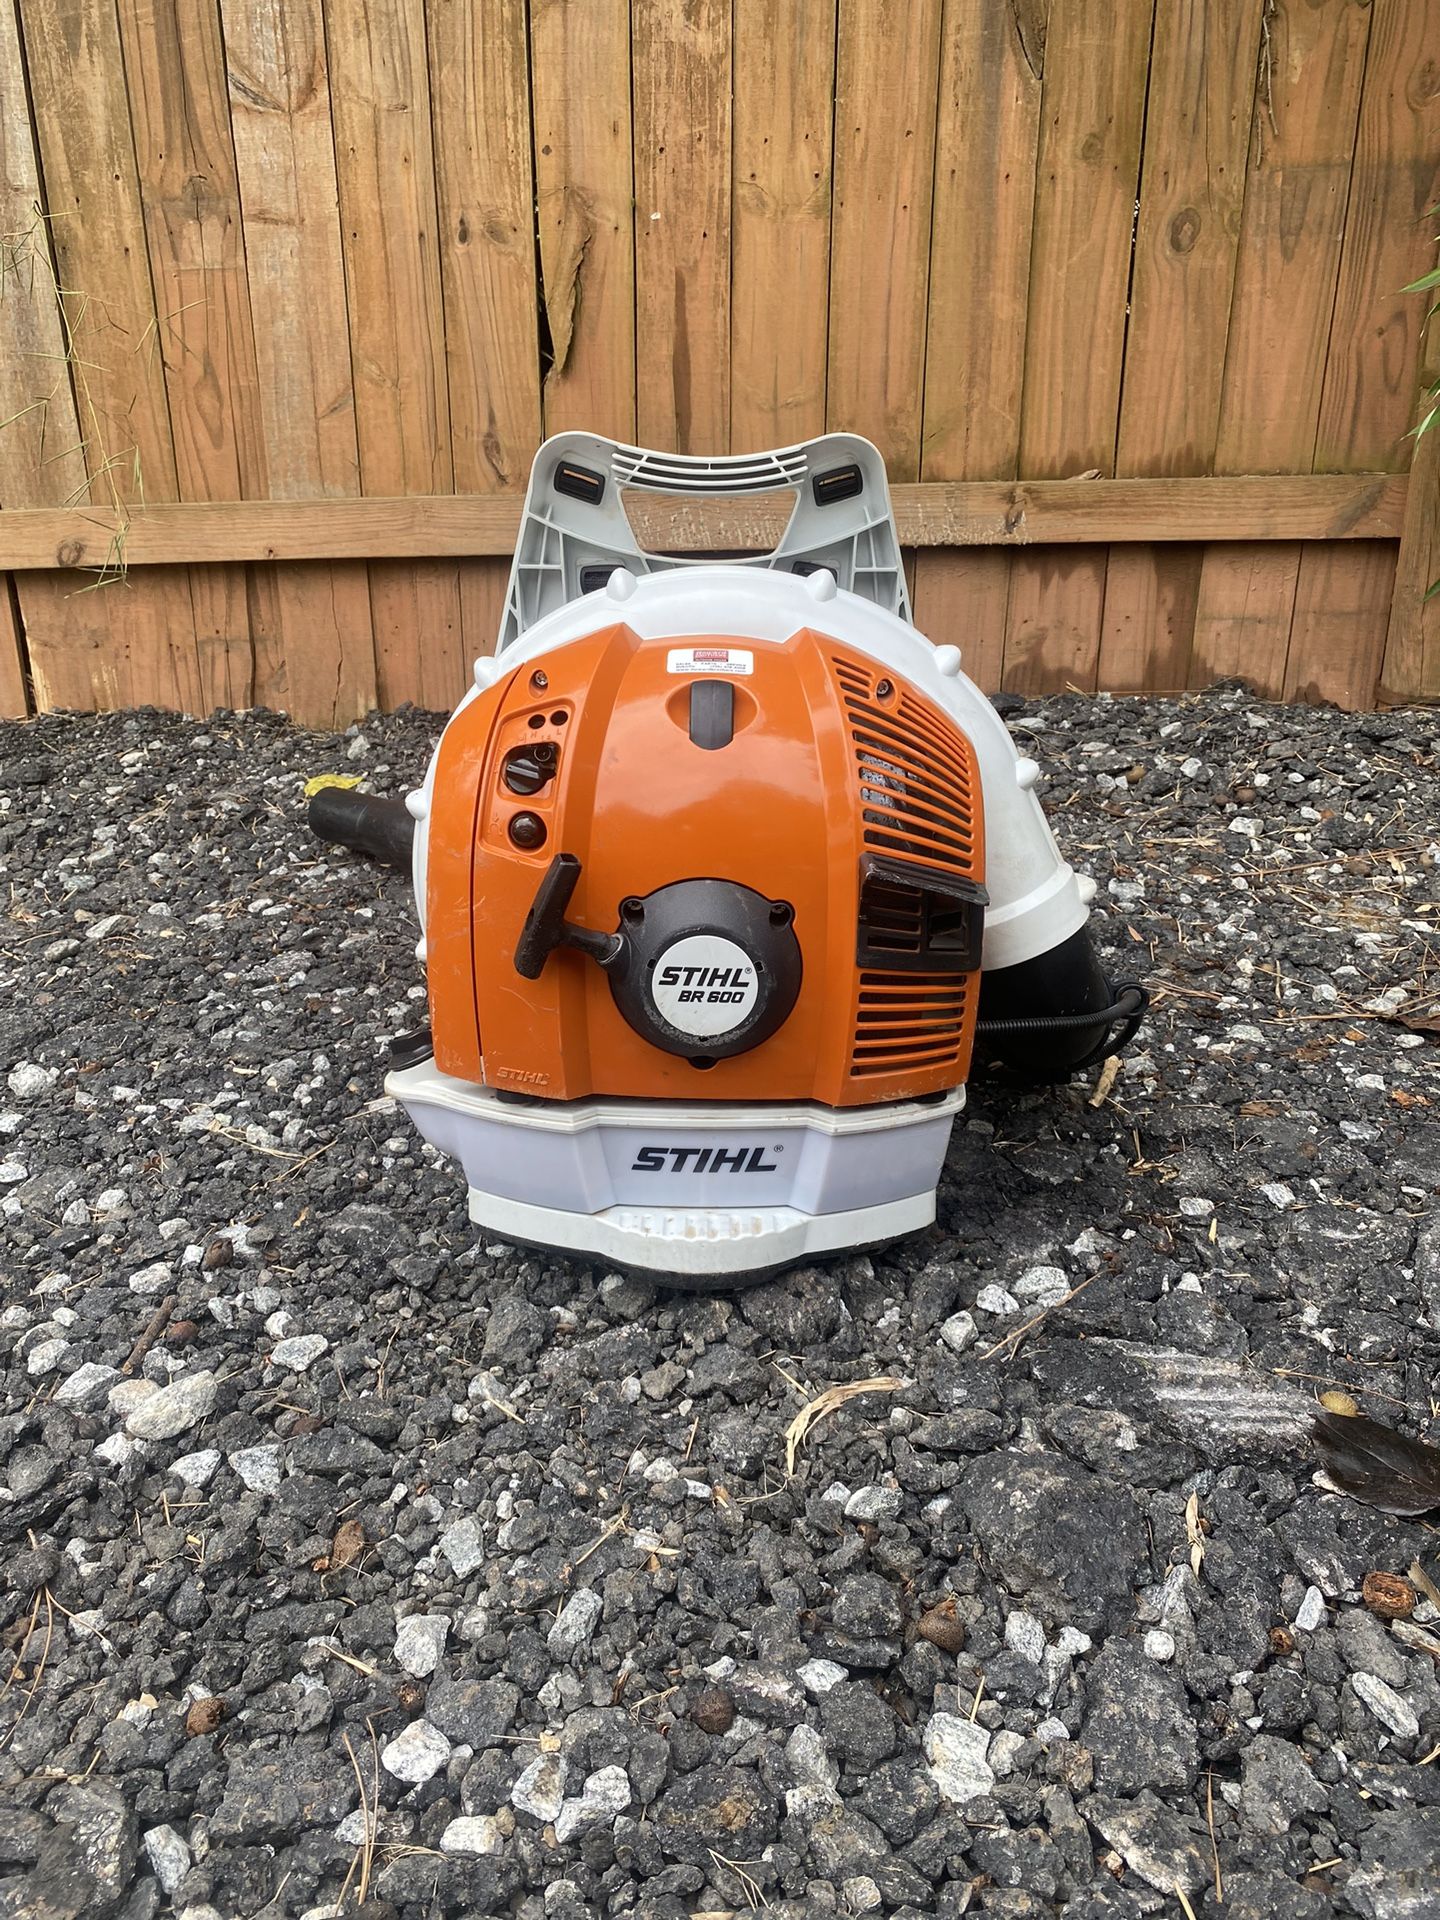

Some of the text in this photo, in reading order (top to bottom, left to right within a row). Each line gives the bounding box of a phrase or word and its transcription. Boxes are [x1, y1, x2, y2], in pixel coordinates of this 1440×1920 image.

[658, 966, 750, 988] STIHL
[678, 990, 745, 1004] BR 600
[496, 1066, 548, 1086] STIHL
[631, 1147, 777, 1173] STIHL
